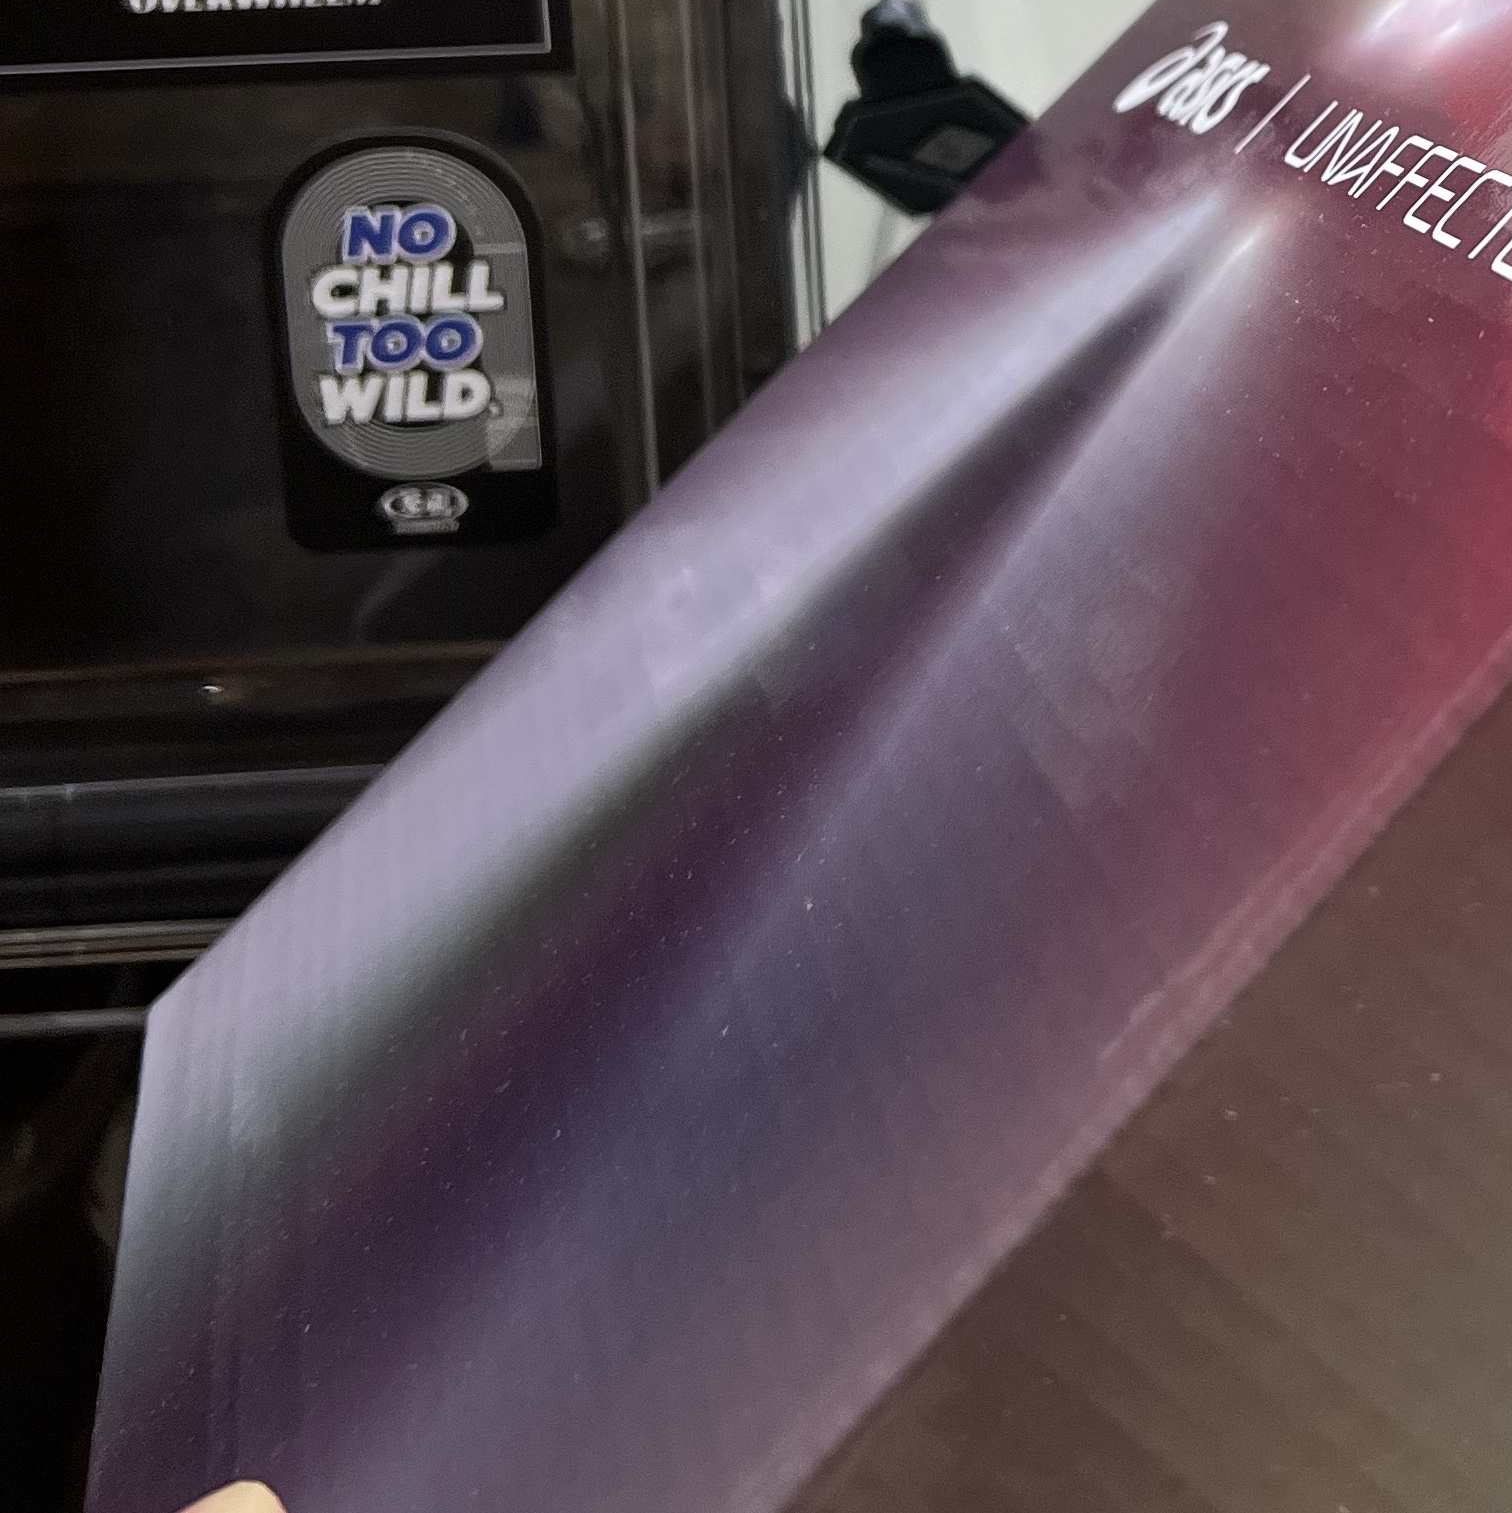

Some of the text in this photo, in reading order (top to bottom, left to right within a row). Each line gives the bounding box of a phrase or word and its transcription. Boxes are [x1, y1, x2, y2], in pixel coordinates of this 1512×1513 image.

[340, 202, 457, 265] NO
[310, 259, 505, 319] CHILL
[326, 314, 484, 376] TOO
